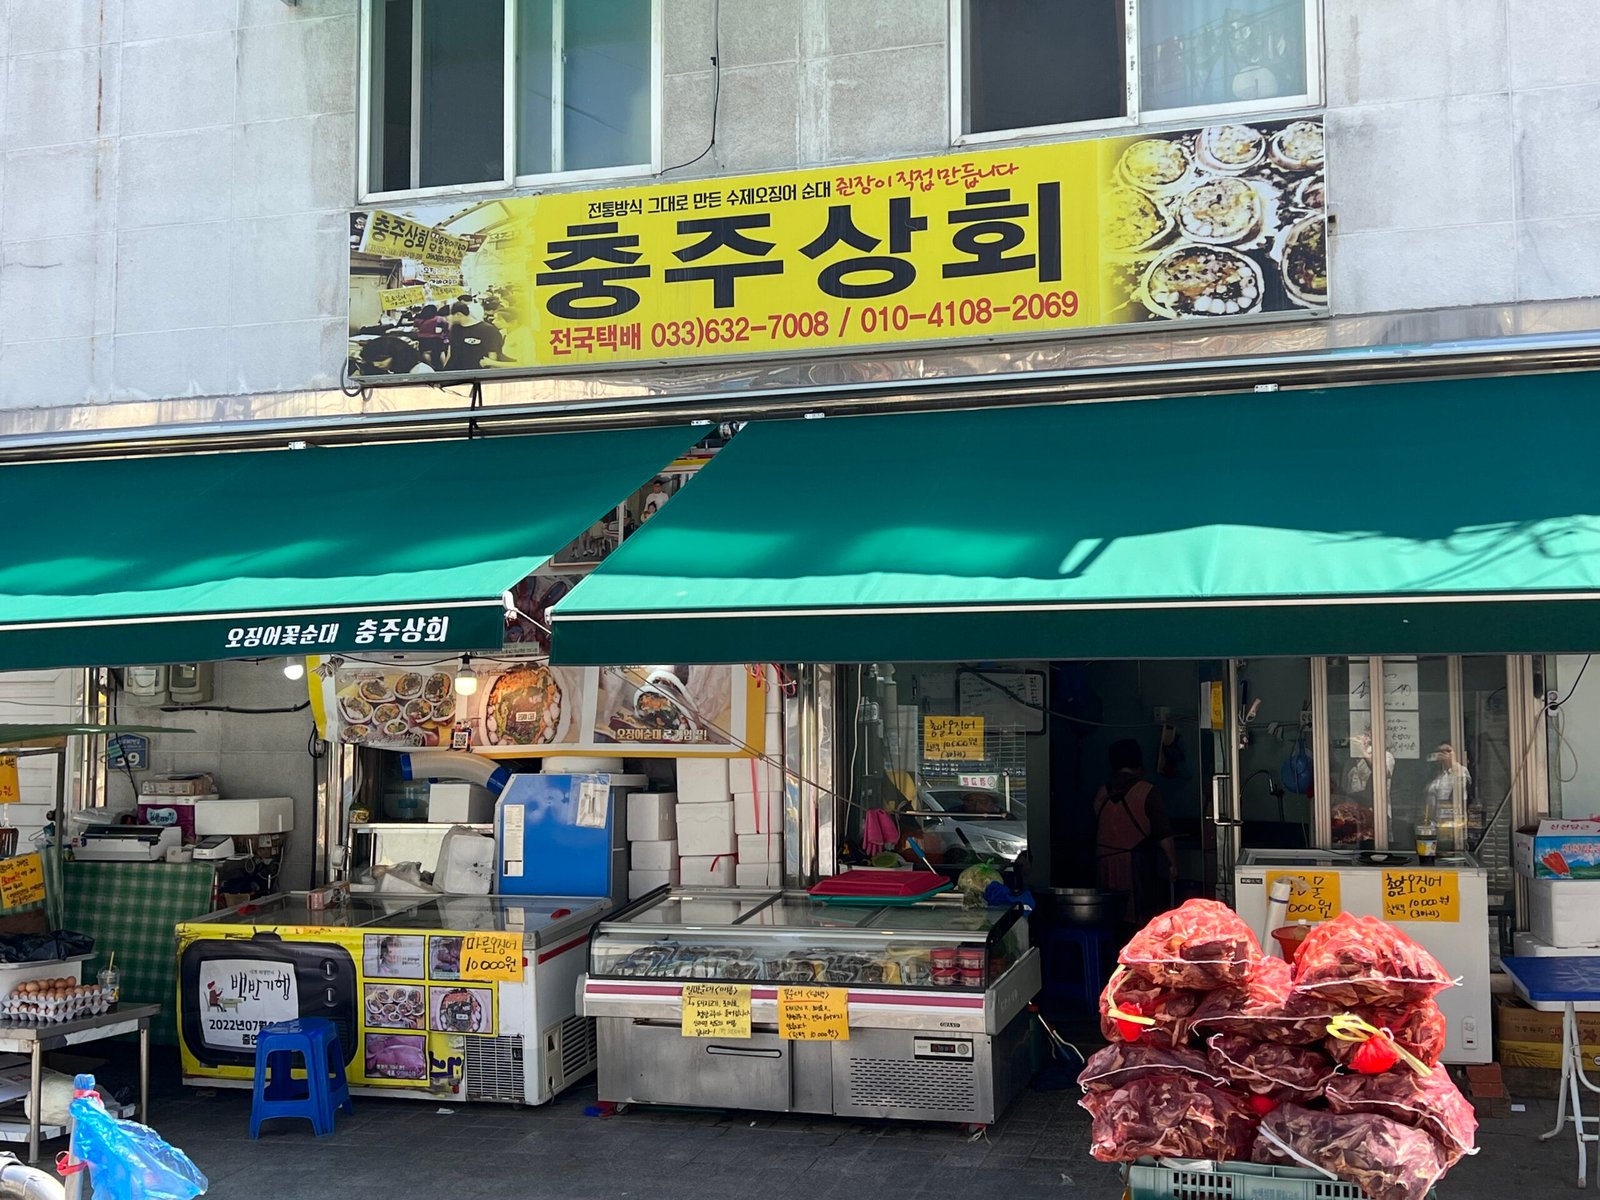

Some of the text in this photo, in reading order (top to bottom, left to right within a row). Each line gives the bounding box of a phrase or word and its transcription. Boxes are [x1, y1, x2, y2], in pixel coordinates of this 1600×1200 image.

[588, 199, 642, 219] 전통방식
[648, 194, 689, 214] 그대로
[693, 191, 721, 210] 만든
[726, 184, 797, 205] 수제오징어
[802, 181, 831, 199] 순대
[897, 168, 935, 191] 직접
[937, 163, 1019, 189] 만듭니다
[536, 181, 1061, 319] 충주상회
[549, 323, 641, 355] 전국택배
[651, 311, 829, 348] 033)632-7008
[861, 290, 1079, 333] 010-4108-2069
[224, 616, 450, 648] 오징어꽃순대 충주상회
[1386, 873, 1442, 897] 총알오징어
[1288, 899, 1333, 919] 000원
[231, 969, 291, 1001] 백반기행
